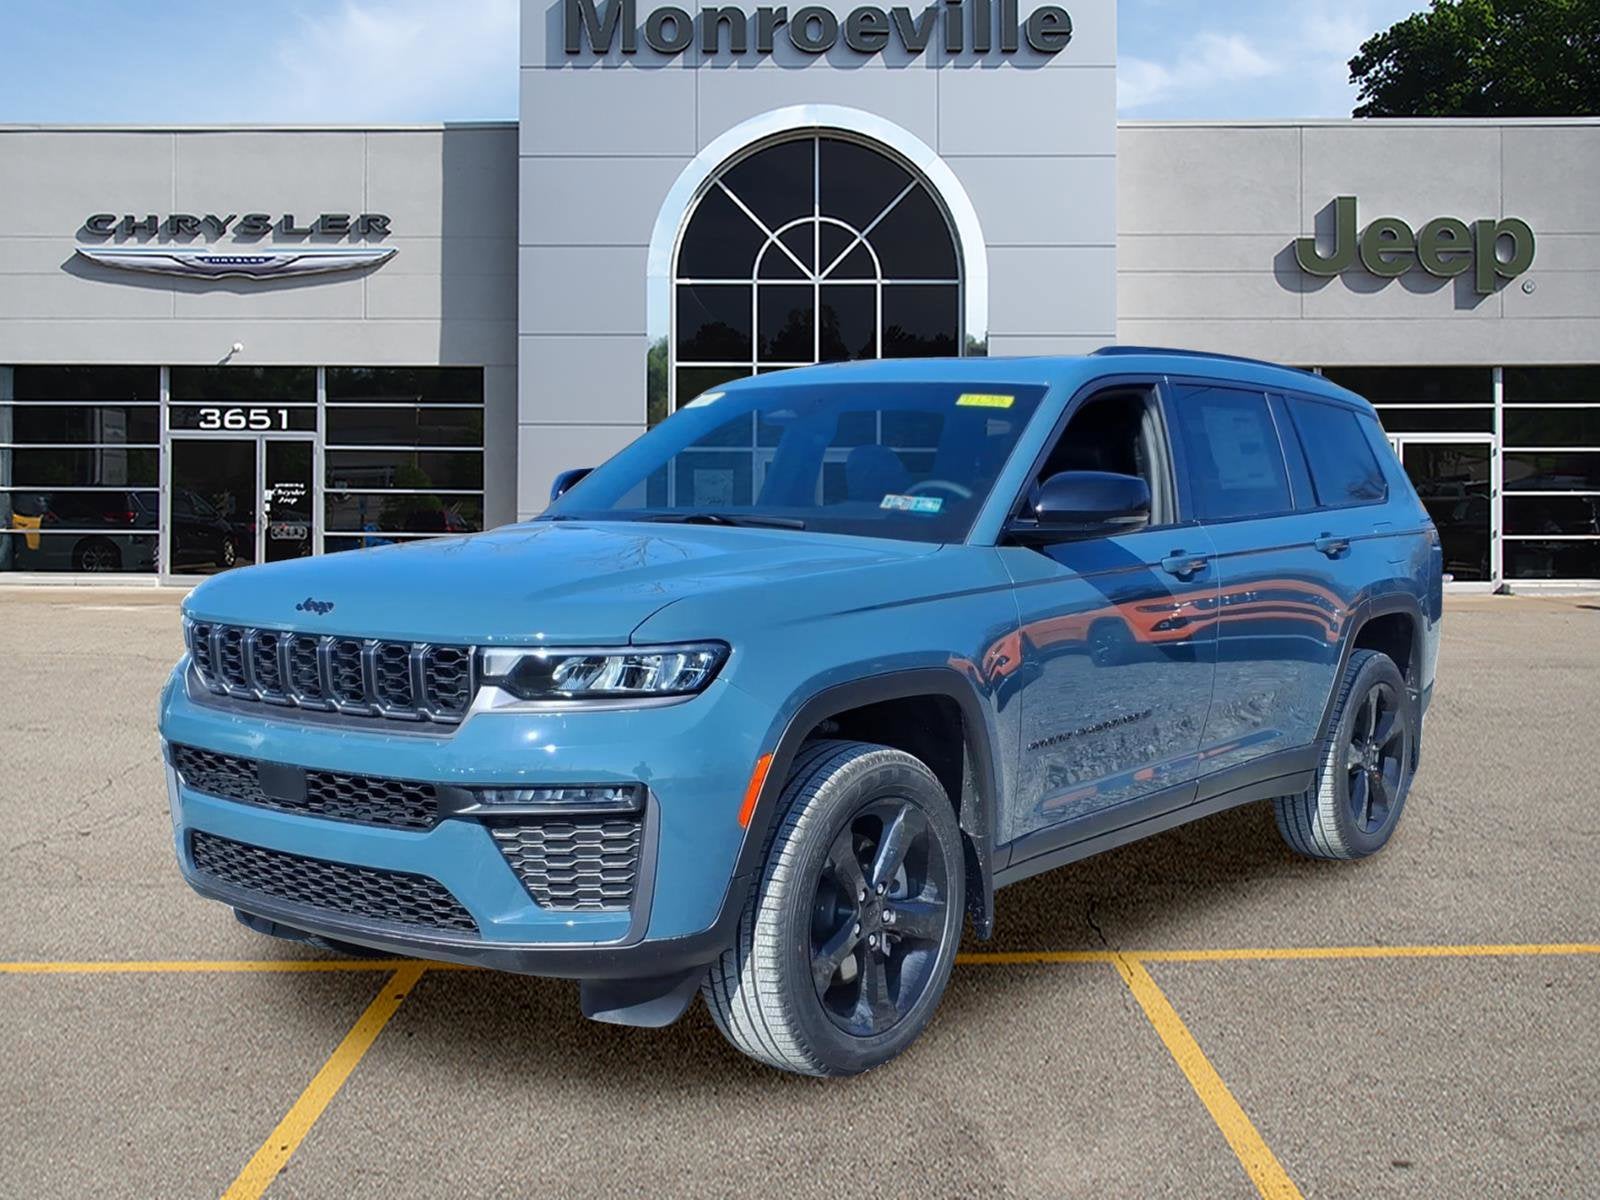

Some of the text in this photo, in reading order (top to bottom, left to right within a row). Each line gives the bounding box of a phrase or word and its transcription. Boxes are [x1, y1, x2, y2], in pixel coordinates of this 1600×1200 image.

[564, 0, 1074, 54] Monroeville
[86, 214, 392, 235] CHRYSLER
[1294, 196, 1536, 294] Jeep
[199, 408, 288, 430] 3651
